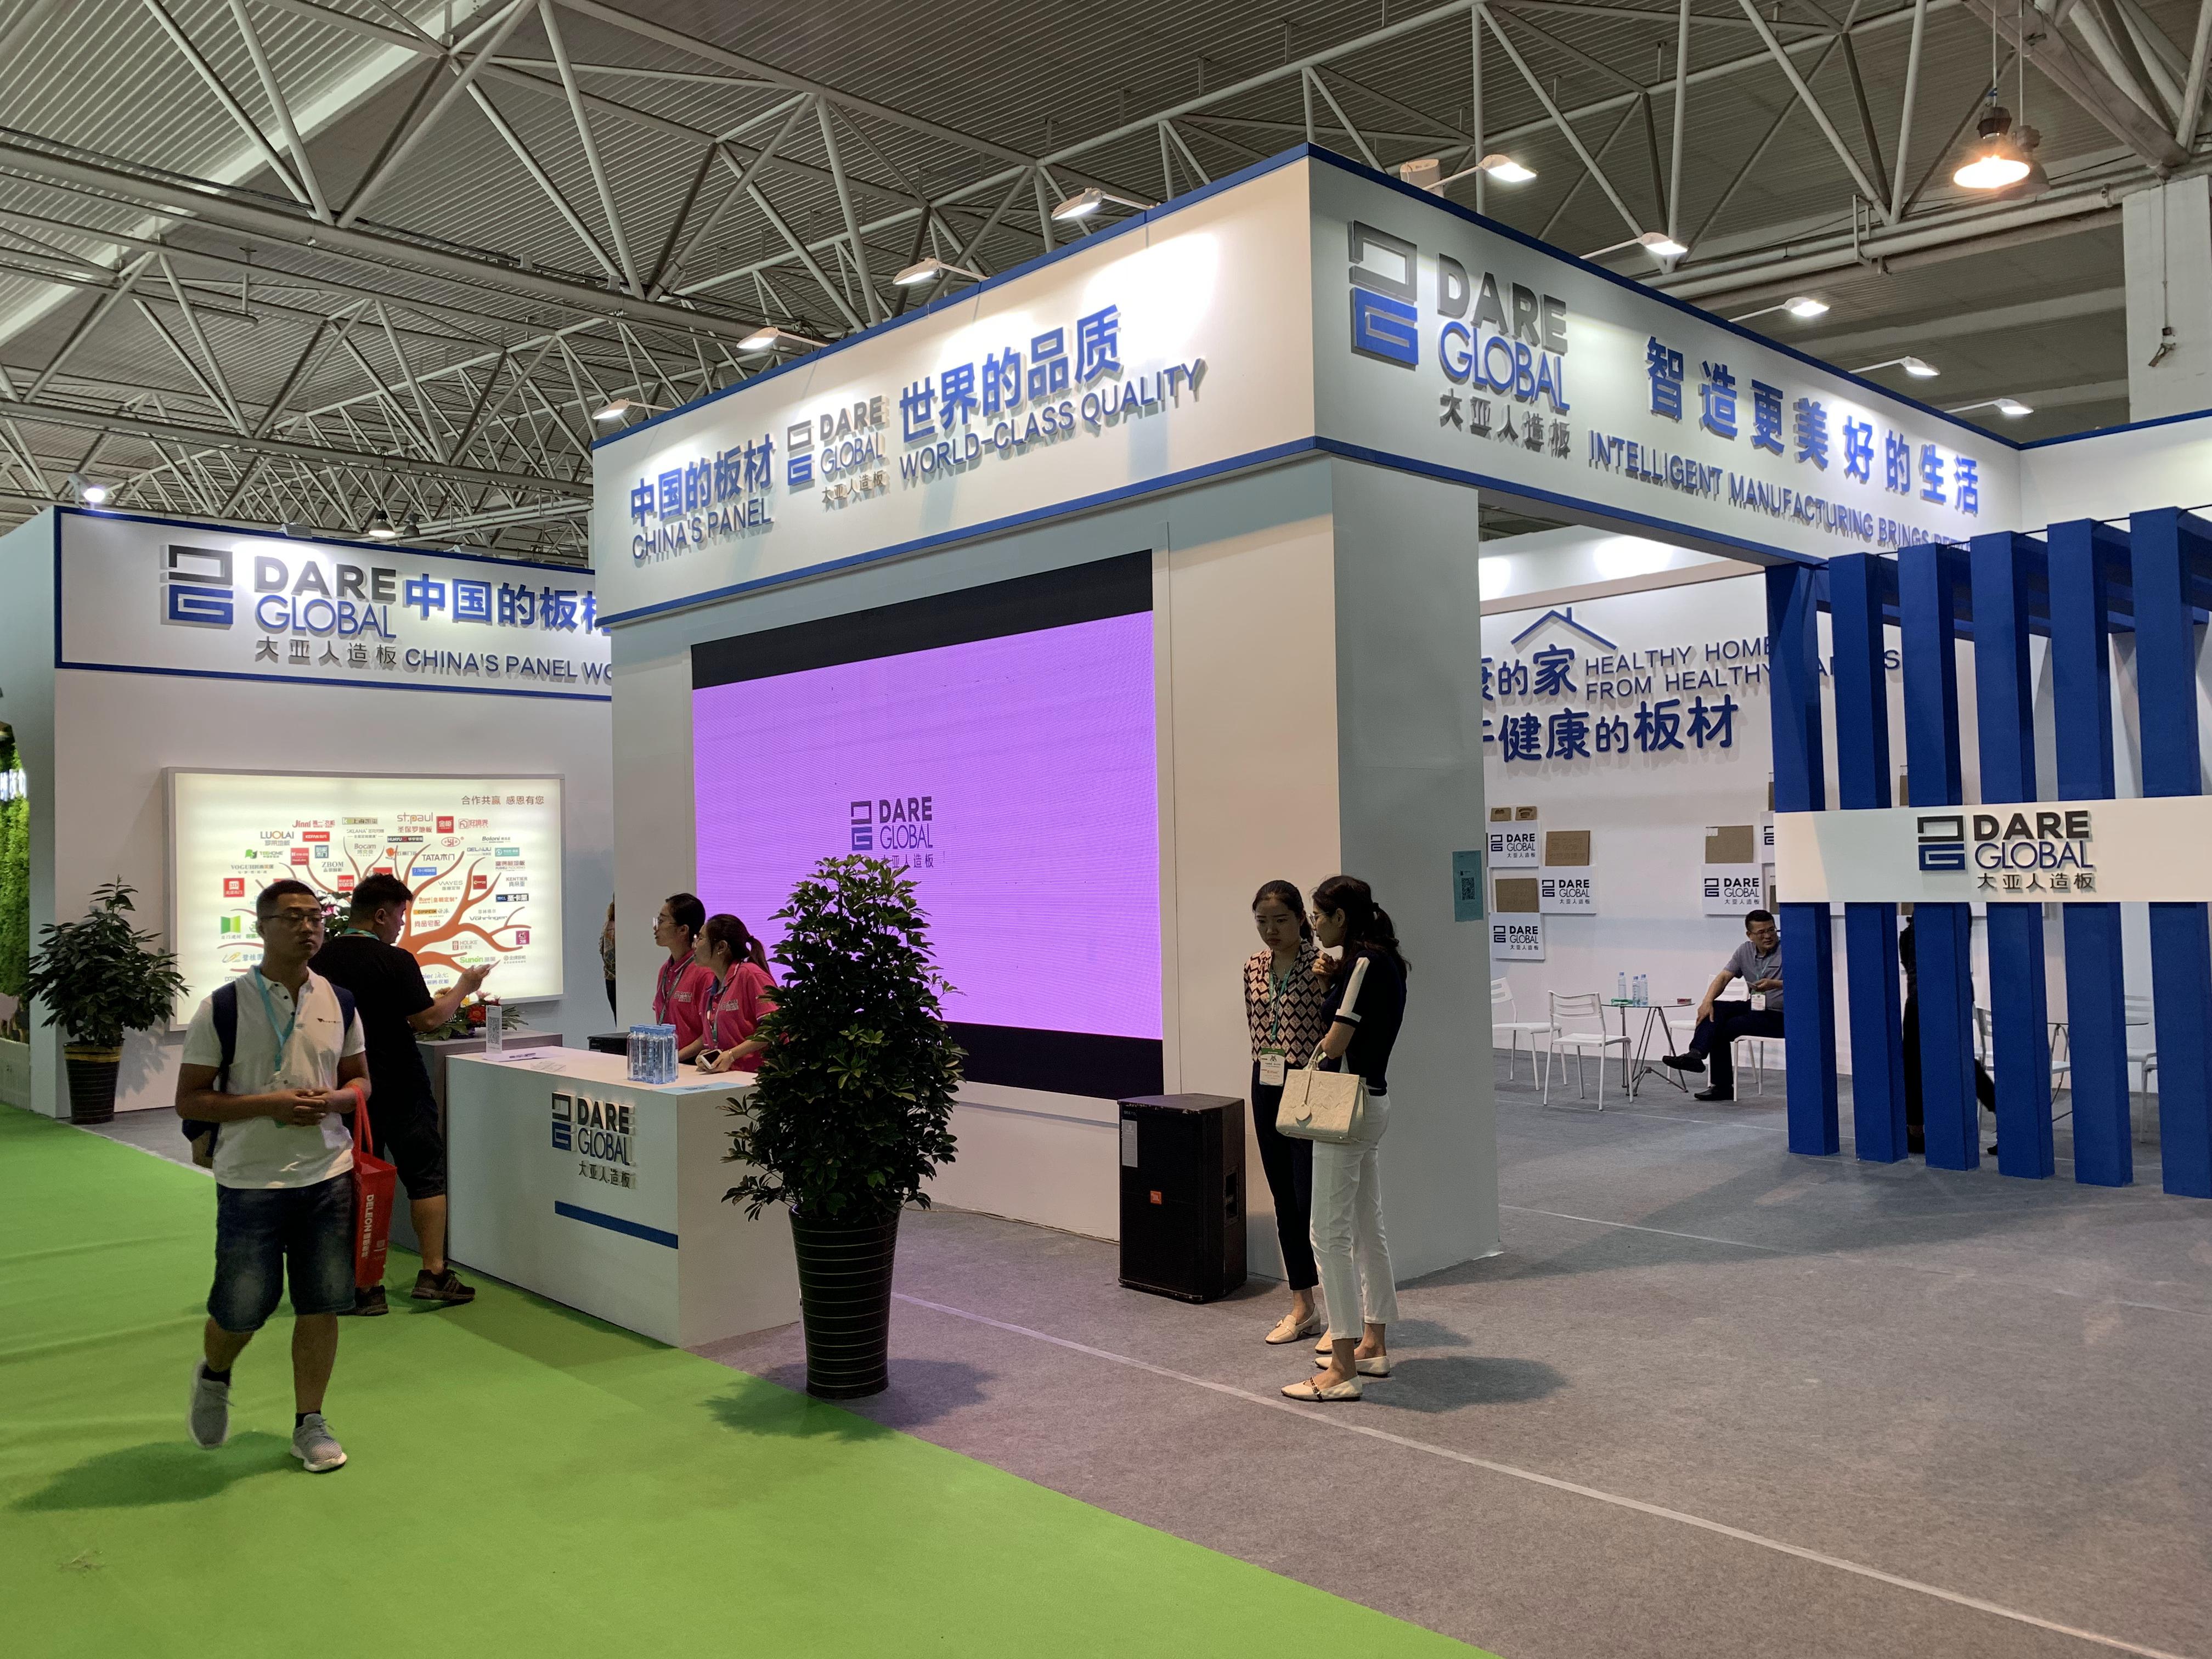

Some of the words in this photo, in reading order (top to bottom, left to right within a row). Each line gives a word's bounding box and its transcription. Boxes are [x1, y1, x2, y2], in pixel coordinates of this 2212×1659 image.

[1437, 253, 1567, 356] DARE
[900, 304, 1122, 443] 世界的品质
[1438, 321, 1570, 416] GLOBAL
[820, 395, 884, 441] DARE
[900, 400, 1074, 479] WORLD-CLASS
[1081, 358, 1205, 426] QUALITY
[1440, 387, 1571, 460] 大亚人造板
[1646, 336, 1978, 517] 智造更美好的生活
[821, 432, 883, 475] GLOBAL
[631, 435, 774, 527] 中国的板材
[822, 470, 883, 503] 大亚人造板
[1588, 430, 1723, 500] INTELLIGENT
[1728, 472, 1874, 543] MANUFACTURING
[1878, 517, 1929, 549] BRINGS
[633, 517, 702, 560] CHINA'S
[708, 497, 771, 538] PANEL
[255, 555, 396, 602] DARE
[255, 595, 397, 639] GLOBAL
[255, 636, 397, 665] 大亚人造板
[405, 648, 499, 672] CHINA'S
[505, 656, 578, 678] PANEL
[1585, 646, 1692, 675] HEALTHY
[1587, 676, 1652, 701] FROM
[461, 795, 501, 805] 合作共赢
[506, 795, 544, 805] 感恩有您
[879, 796, 932, 823] DARE
[260, 830, 295, 839] LUOLAI
[880, 823, 933, 850] GLOBAL
[1506, 833, 1535, 843] DARE
[1975, 810, 2090, 841] DARE
[1506, 843, 1535, 851] GLOBAL
[1974, 841, 2094, 870] GLOBAL
[1559, 879, 1590, 888] DARE
[1559, 889, 1590, 898] GLOBAL
[1724, 878, 1759, 887] DARE
[1724, 888, 1759, 898] GLOBAL
[1977, 872, 2095, 891] 大亚人造板
[1509, 926, 1538, 934] DARE
[1510, 935, 1538, 944] GLOBAL
[578, 1097, 630, 1135] DARE
[578, 1127, 630, 1166] GLOBAL
[578, 1160, 631, 1189] 大亚人造板
